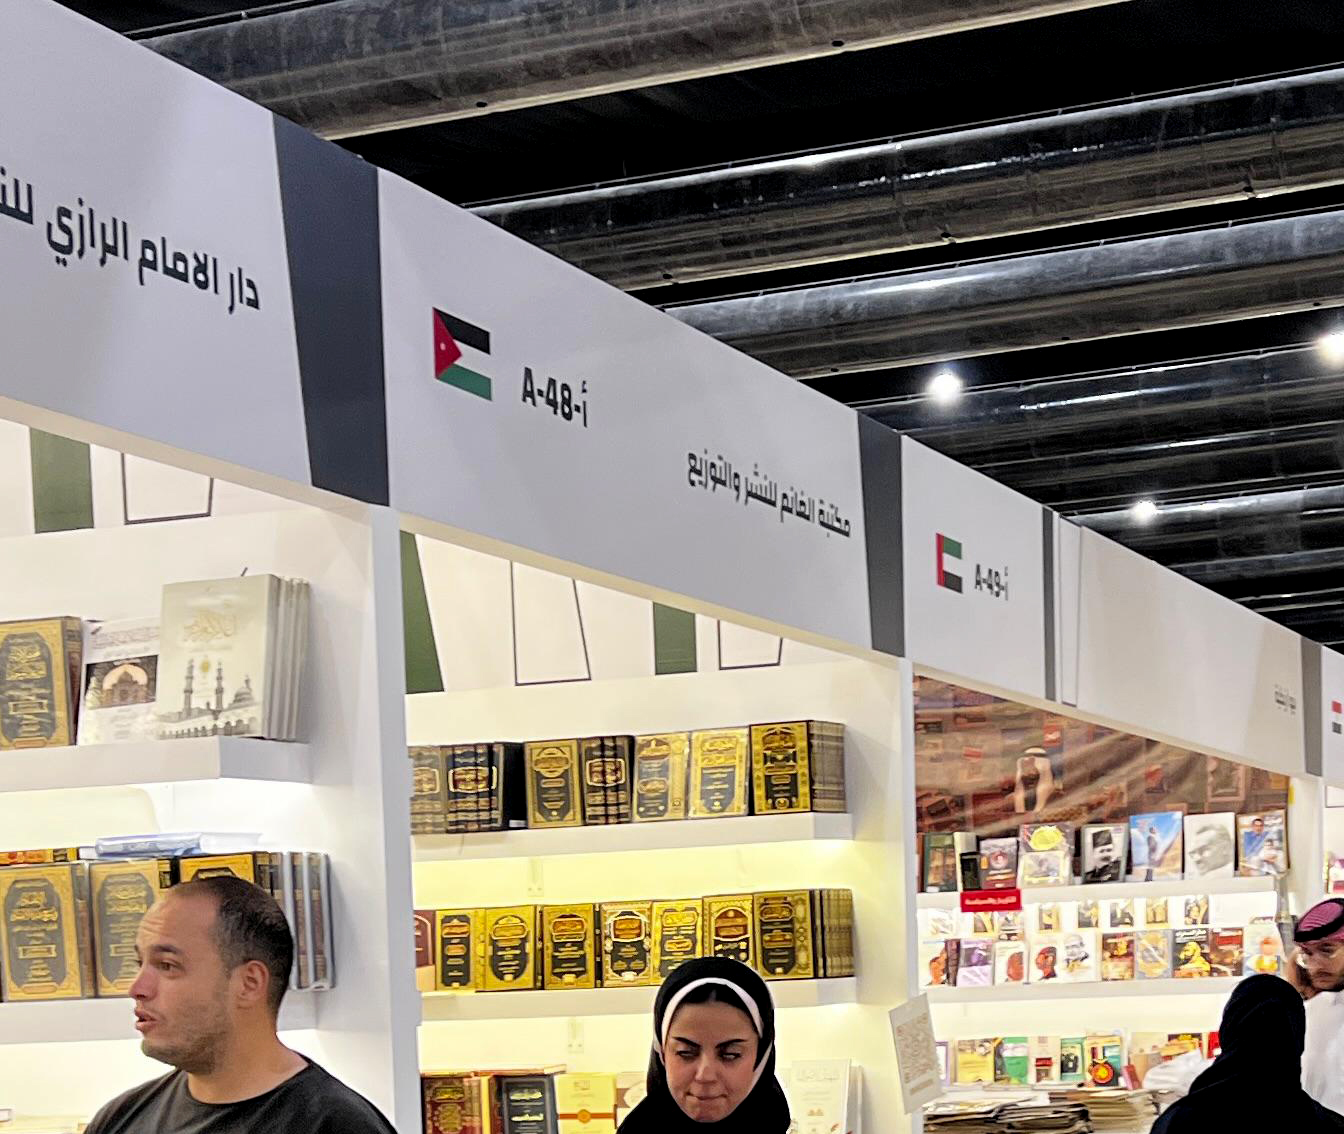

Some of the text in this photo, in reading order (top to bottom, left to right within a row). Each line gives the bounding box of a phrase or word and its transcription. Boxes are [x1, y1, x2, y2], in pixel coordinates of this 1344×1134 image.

[45, 197, 129, 267] الرازي
[137, 233, 219, 295] الامام
[228, 266, 261, 314] دار
[688, 448, 851, 538] مكتبة الغانم للنشر والتوزيع
